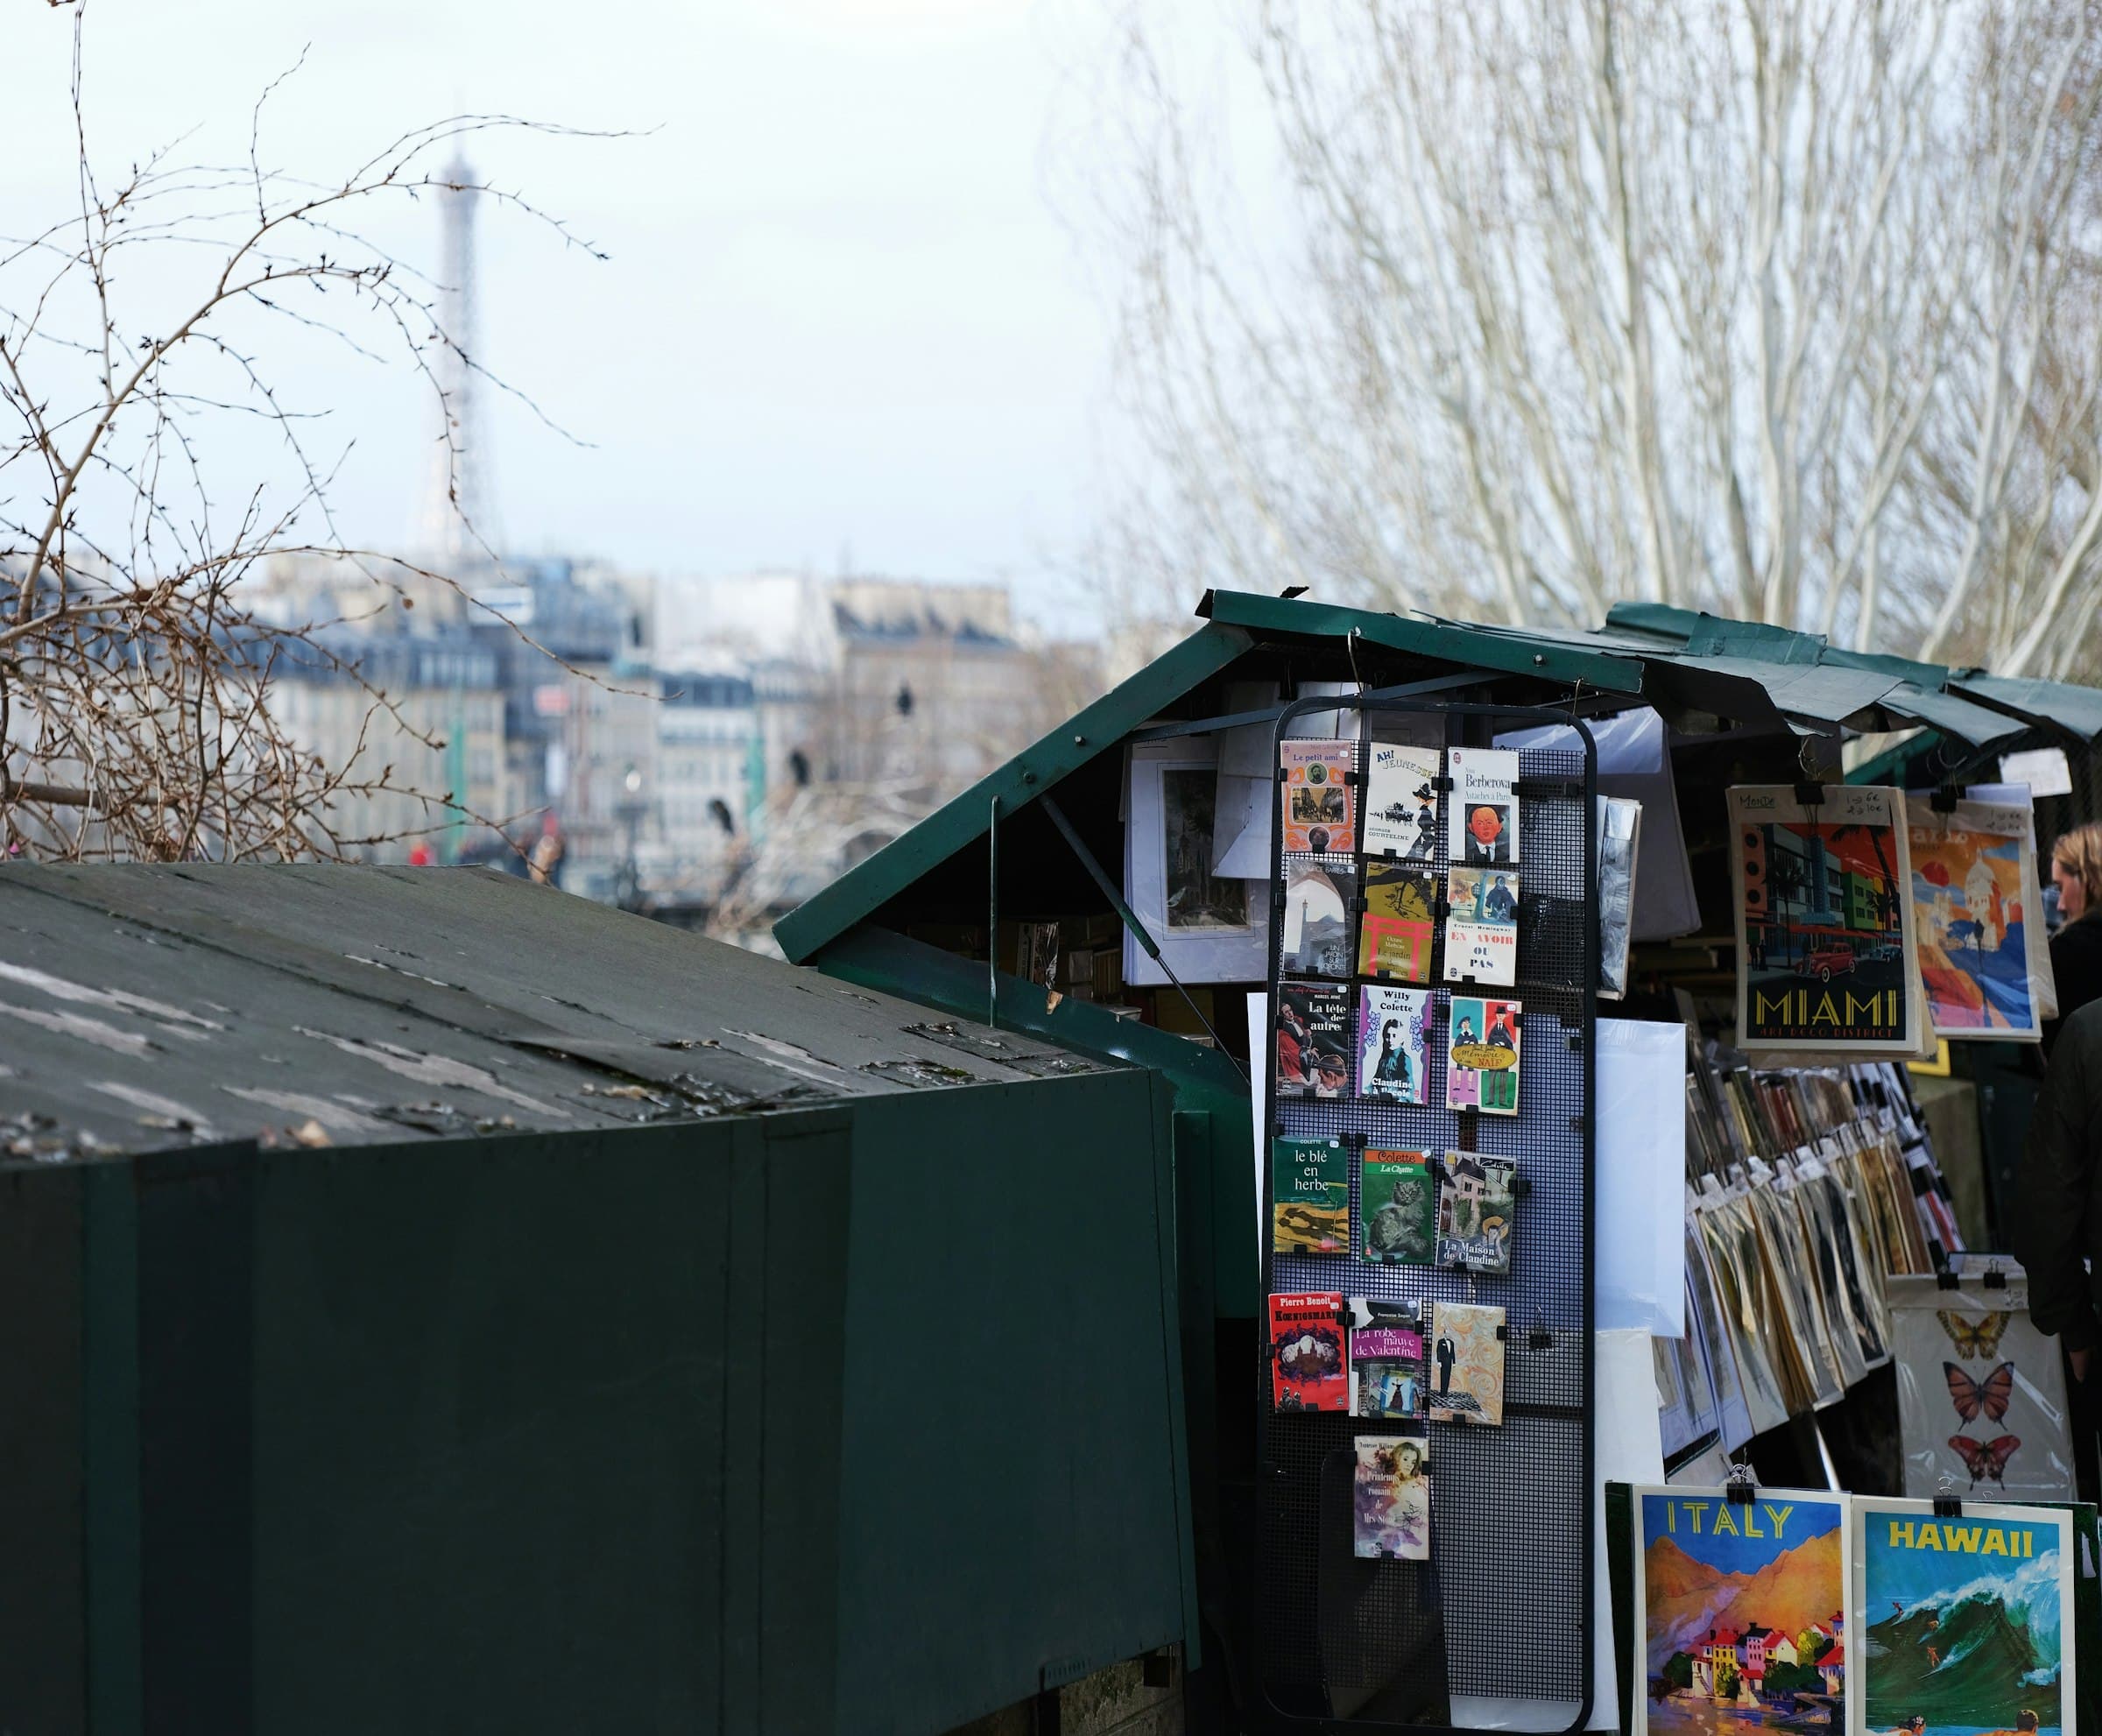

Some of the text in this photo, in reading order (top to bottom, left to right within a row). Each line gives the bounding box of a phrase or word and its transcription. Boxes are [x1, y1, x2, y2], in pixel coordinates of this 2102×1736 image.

[1305, 753, 1323, 763] petit
[1376, 750, 1394, 762] AH!
[1465, 773, 1511, 789] Berberova
[1451, 931, 1513, 945] EN AVOIR
[1473, 946, 1491, 956] OU
[1470, 959, 1493, 969] PAS
[1384, 991, 1410, 1001] Willy
[1308, 1001, 1347, 1014] La tête
[1380, 1002, 1413, 1013] Colette
[1756, 989, 1897, 1027] MIAMI
[1833, 1027, 1893, 1038] DISTRICT
[1372, 1077, 1414, 1089] Claudine
[1372, 1086, 1379, 1095] à
[1294, 1149, 1328, 1163] le blé
[1378, 1151, 1416, 1163] Colette
[1303, 1167, 1318, 1176] en
[1391, 1165, 1414, 1175] Chatte
[1294, 1178, 1329, 1191] herbe
[1444, 1239, 1495, 1256] La Maison
[1443, 1250, 1499, 1267] de Claudine
[1280, 1296, 1331, 1307] Pierre Benoit
[1357, 1327, 1396, 1339] La robe
[1384, 1337, 1414, 1347] mauve
[1355, 1345, 1416, 1358] de Valentine
[1366, 1471, 1400, 1483] Printemps
[1368, 1485, 1391, 1496] romain
[1375, 1499, 1383, 1510] de
[1666, 1500, 1795, 1539] ITALY
[1888, 1521, 2034, 1558] HAWAII
